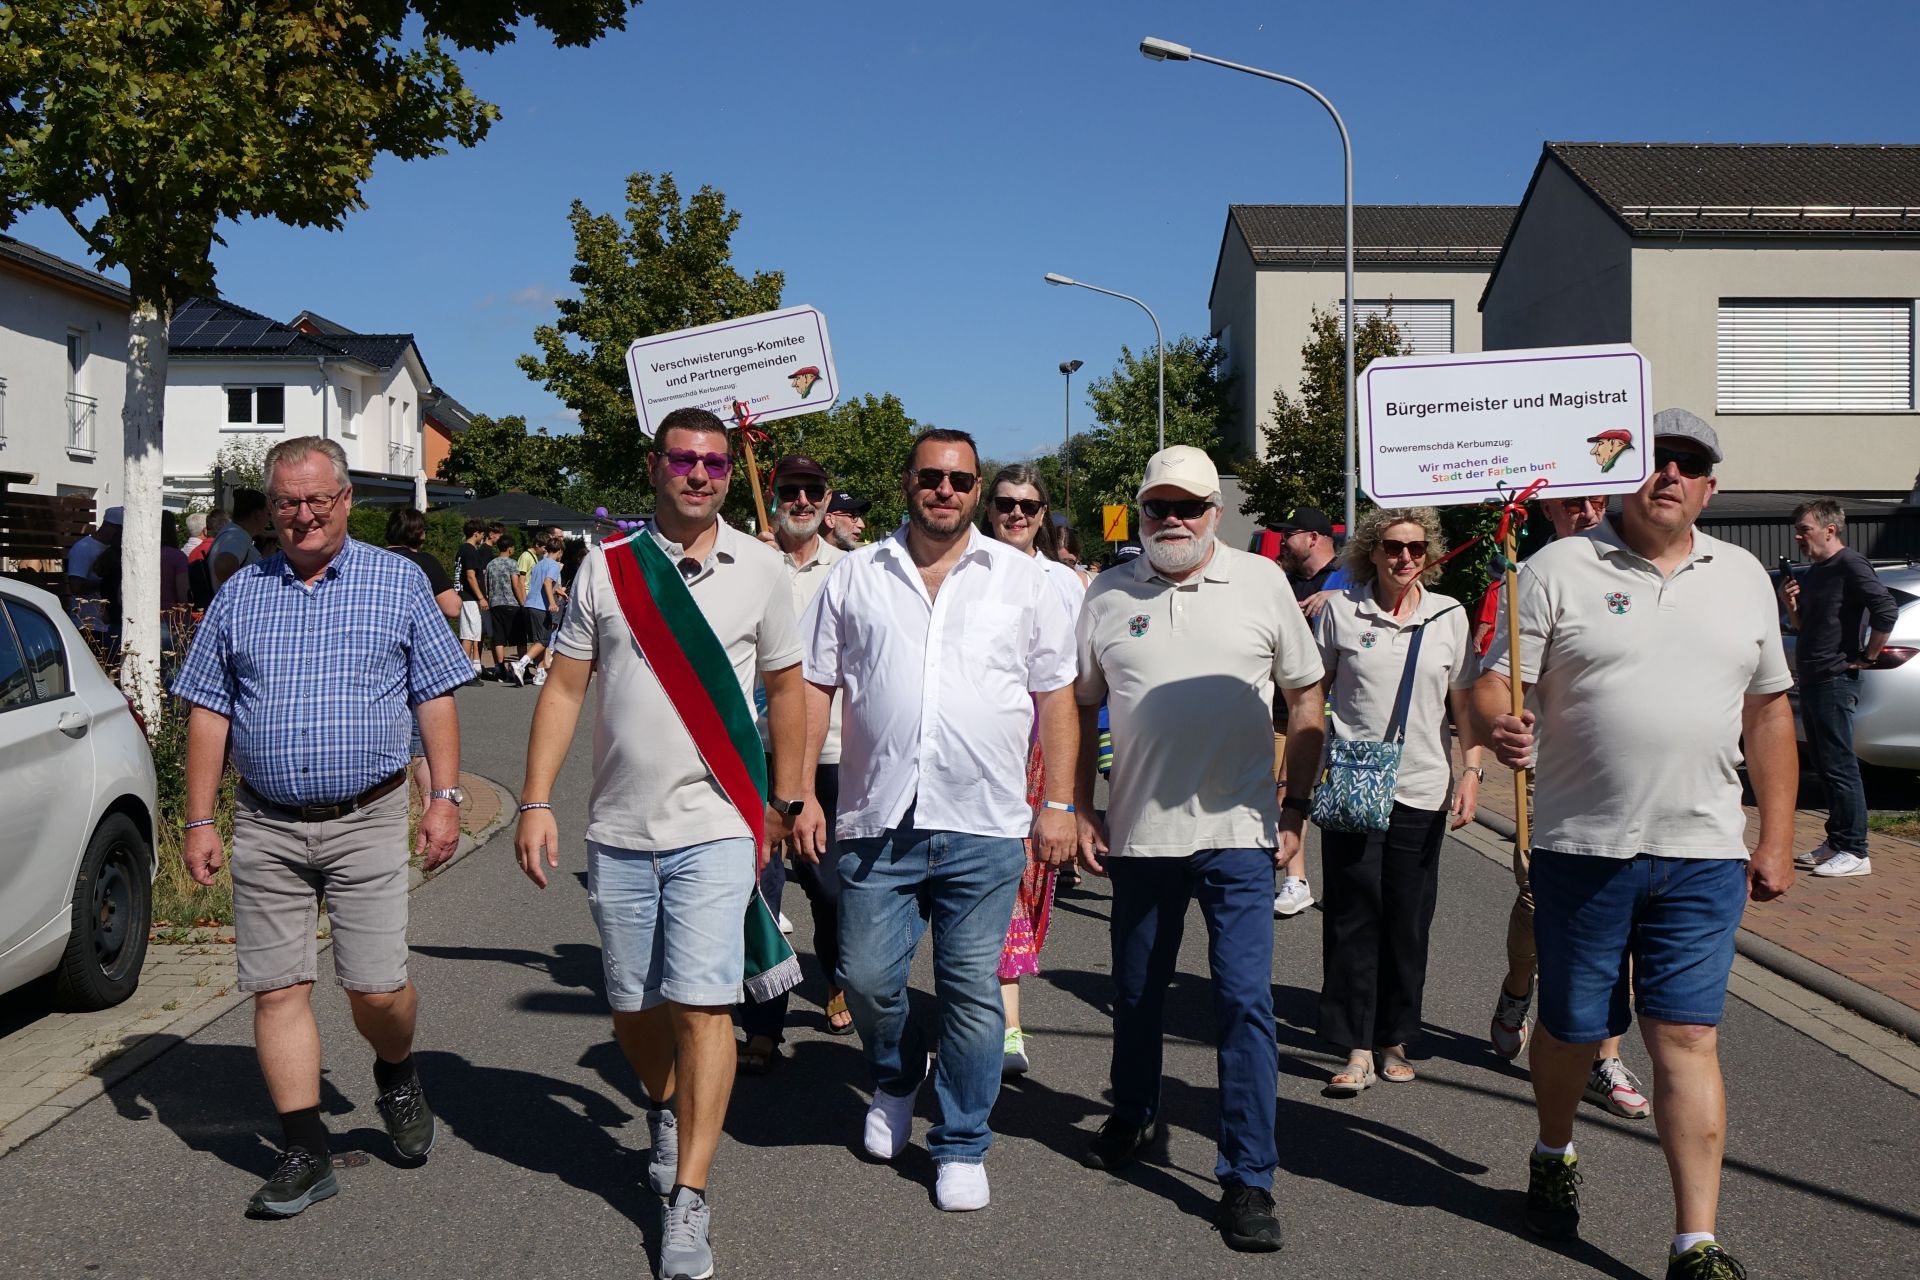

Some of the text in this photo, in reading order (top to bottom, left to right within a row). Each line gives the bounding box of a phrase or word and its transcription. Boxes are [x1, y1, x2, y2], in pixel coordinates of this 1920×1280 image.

[651, 335, 805, 373] Verschwisterungs-Komitee
[666, 353, 797, 387] und Partnergemeinden
[698, 383, 737, 395] Kerbumzug:
[724, 394, 736, 402] die
[752, 394, 770, 404] bunt
[1386, 389, 1628, 418] Bürgermeister und Magistrat
[1379, 438, 1513, 453] Owweremschdä Kerbumzug:
[1419, 455, 1509, 473] Wir machen die
[1432, 461, 1557, 483] Stadt der Farben bunt
